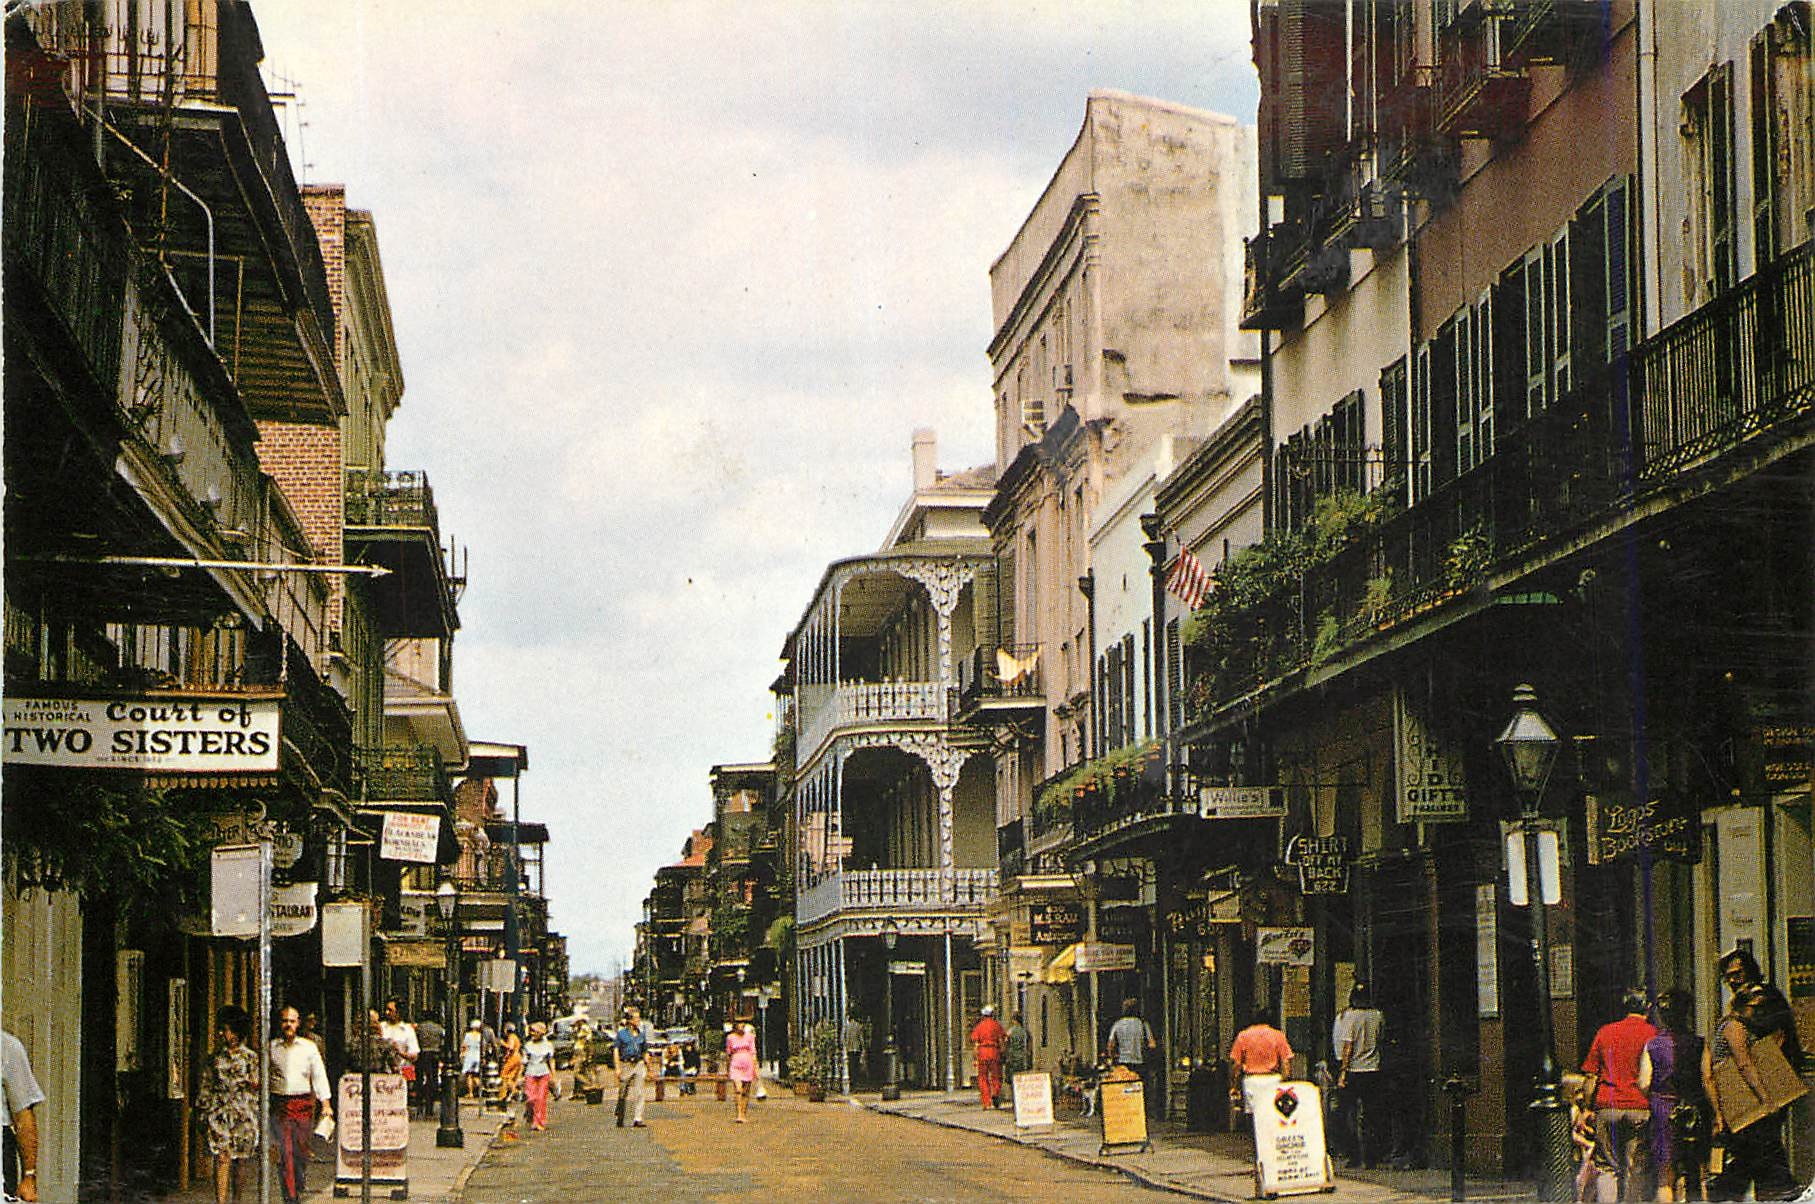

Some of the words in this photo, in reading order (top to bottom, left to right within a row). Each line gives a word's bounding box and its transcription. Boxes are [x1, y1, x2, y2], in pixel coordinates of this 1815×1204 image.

[25, 701, 78, 711] FAMOUS
[14, 712, 91, 722] HISTORICAL
[105, 703, 203, 722] Court
[218, 702, 252, 728] of
[4, 728, 92, 753] TWO
[111, 730, 270, 755] SISTERS
[1298, 837, 1347, 854] SHIRT
[1308, 867, 1342, 879] BACK
